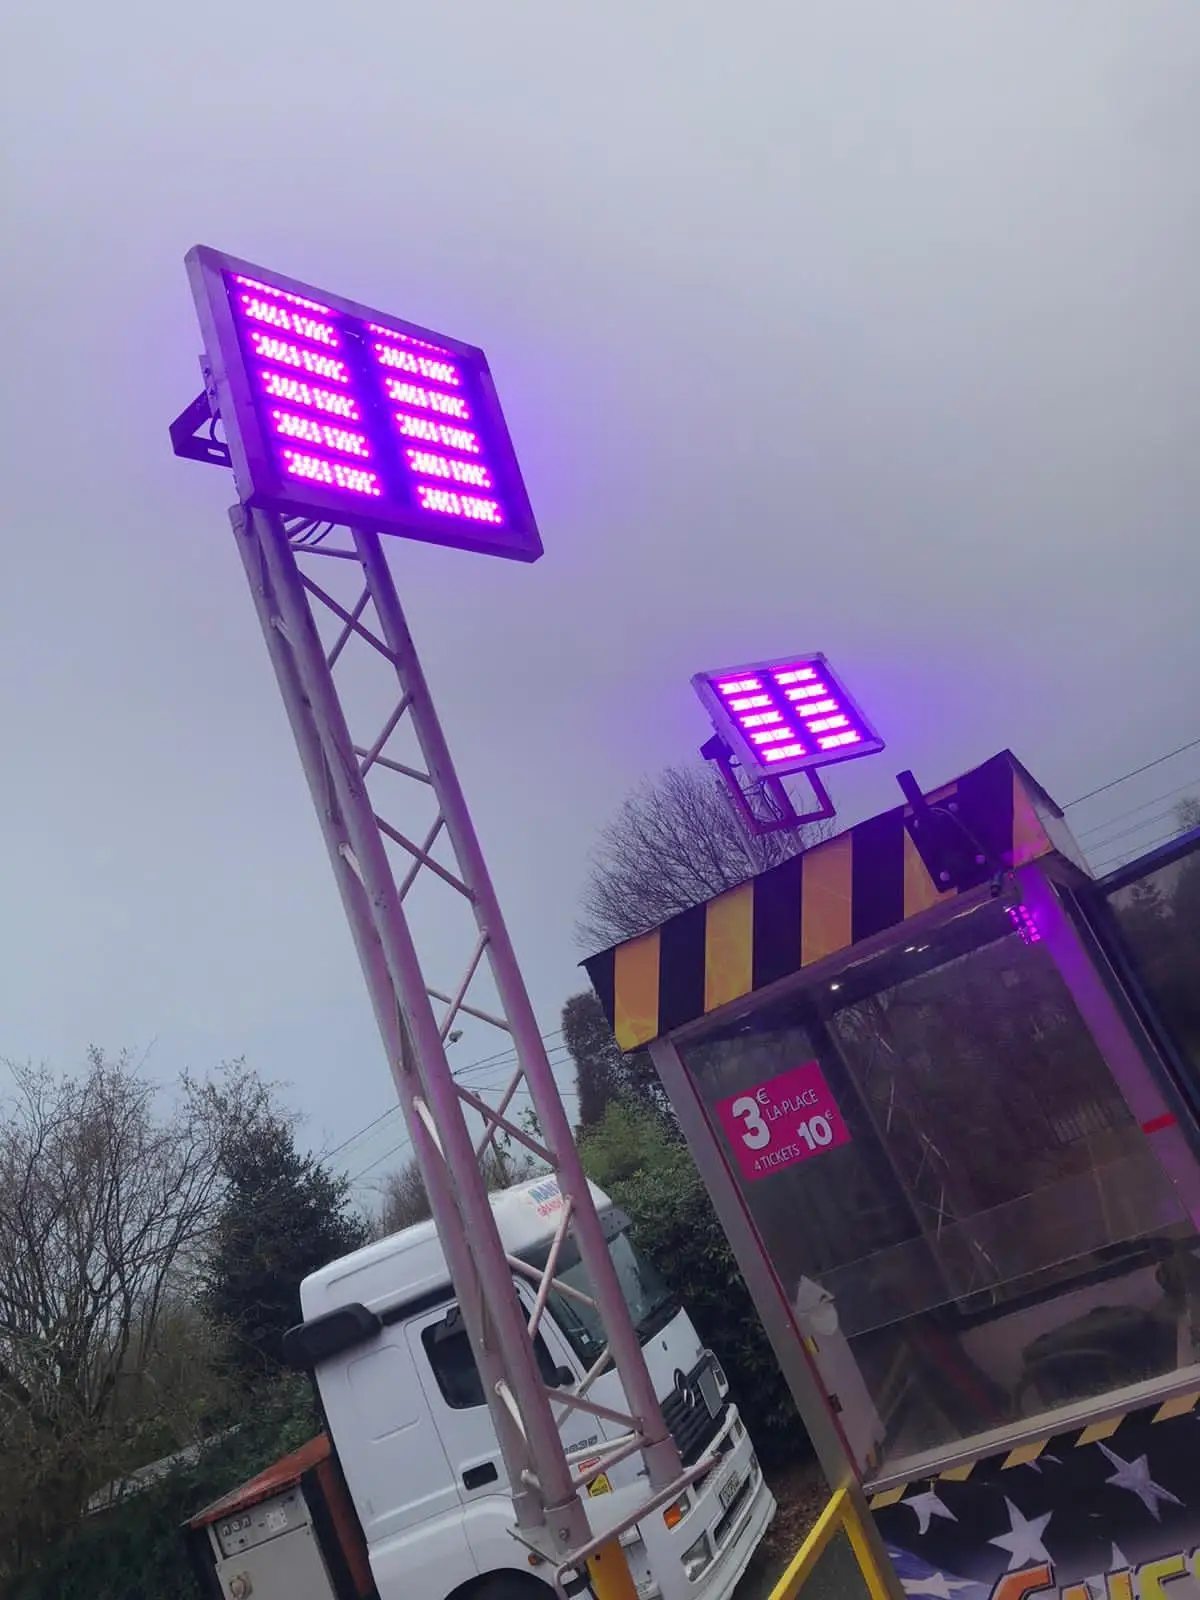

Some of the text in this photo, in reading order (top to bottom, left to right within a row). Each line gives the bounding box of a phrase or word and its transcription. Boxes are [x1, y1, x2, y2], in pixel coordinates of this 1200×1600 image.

[765, 1104, 782, 1121] LA
[782, 1088, 819, 1112] PLACE
[760, 1143, 801, 1169] TICKETS
